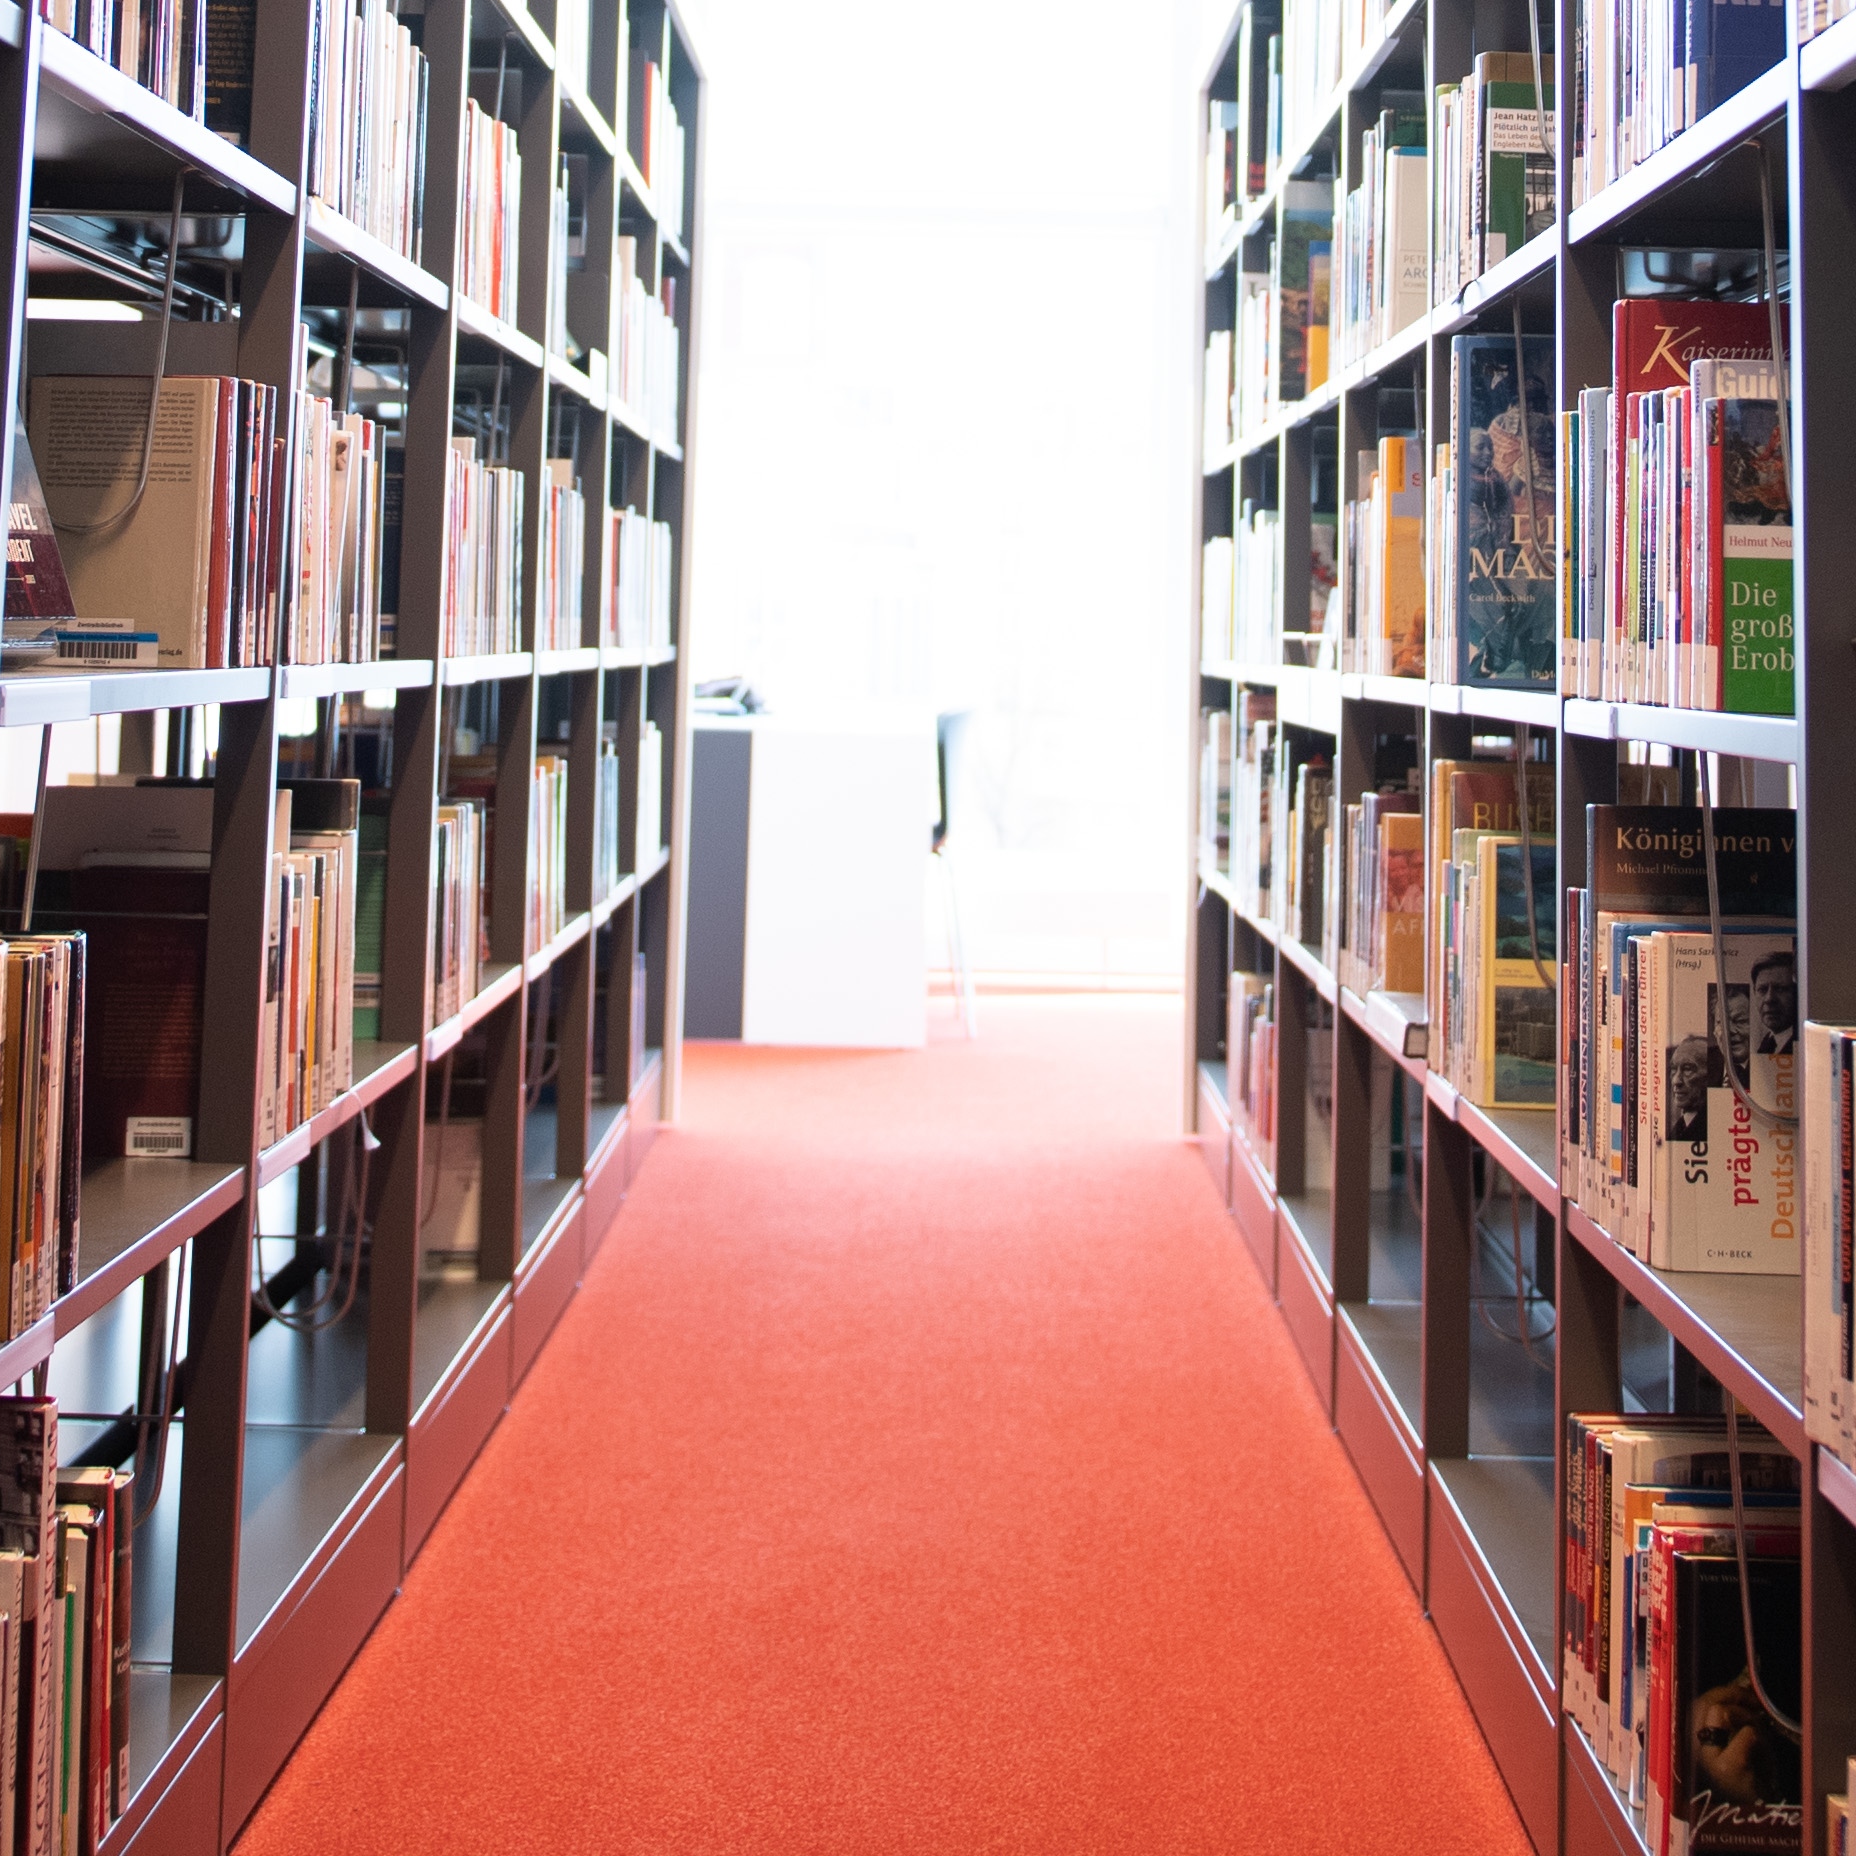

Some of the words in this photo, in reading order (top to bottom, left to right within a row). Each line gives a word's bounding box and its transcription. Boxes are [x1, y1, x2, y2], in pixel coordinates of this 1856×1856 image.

[1494, 112, 1514, 121] Jean
[1516, 113, 1554, 122] Hatzld
[1494, 123, 1528, 132] Plötzlich
[1494, 131, 1506, 140] Das
[1508, 133, 1528, 141] Leben
[1403, 254, 1427, 264] PETE
[9, 502, 38, 531] AVEL
[1511, 513, 1556, 545] DI
[1729, 534, 1768, 548] Helmut
[1771, 535, 1793, 548] Neu
[1469, 547, 1556, 581] MAS
[1469, 592, 1493, 603] Carol
[1495, 592, 1536, 604] Beckwith
[1730, 581, 1778, 608] Die
[1730, 614, 1793, 644] groß
[1730, 645, 1794, 672] Erob
[1616, 862, 1661, 875] Michael
[1675, 946, 1696, 956] Hans
[1675, 959, 1702, 970] (Hrsg.)
[1637, 948, 1648, 1001] Führer
[1651, 944, 1660, 1044] Deutschland
[1638, 1004, 1648, 1028] den
[1638, 1032, 1648, 1096] liebten
[1651, 1048, 1661, 1112] prägten
[1639, 1101, 1648, 1125] Sie
[1652, 1116, 1660, 1142] Sie
[1769, 1054, 1795, 1240] Deutschland
[1685, 1140, 1708, 1185] Sie
[1587, 1468, 1595, 1500] NAZIS
[1602, 1472, 1612, 1561] Geschichte
[1587, 1524, 1595, 1566] FRAUEN
[1602, 1565, 1610, 1592] der
[1601, 1597, 1610, 1638] Seite
[1600, 1643, 1609, 1674] Ihre
[1723, 1834, 1764, 1846] GEHEIME
